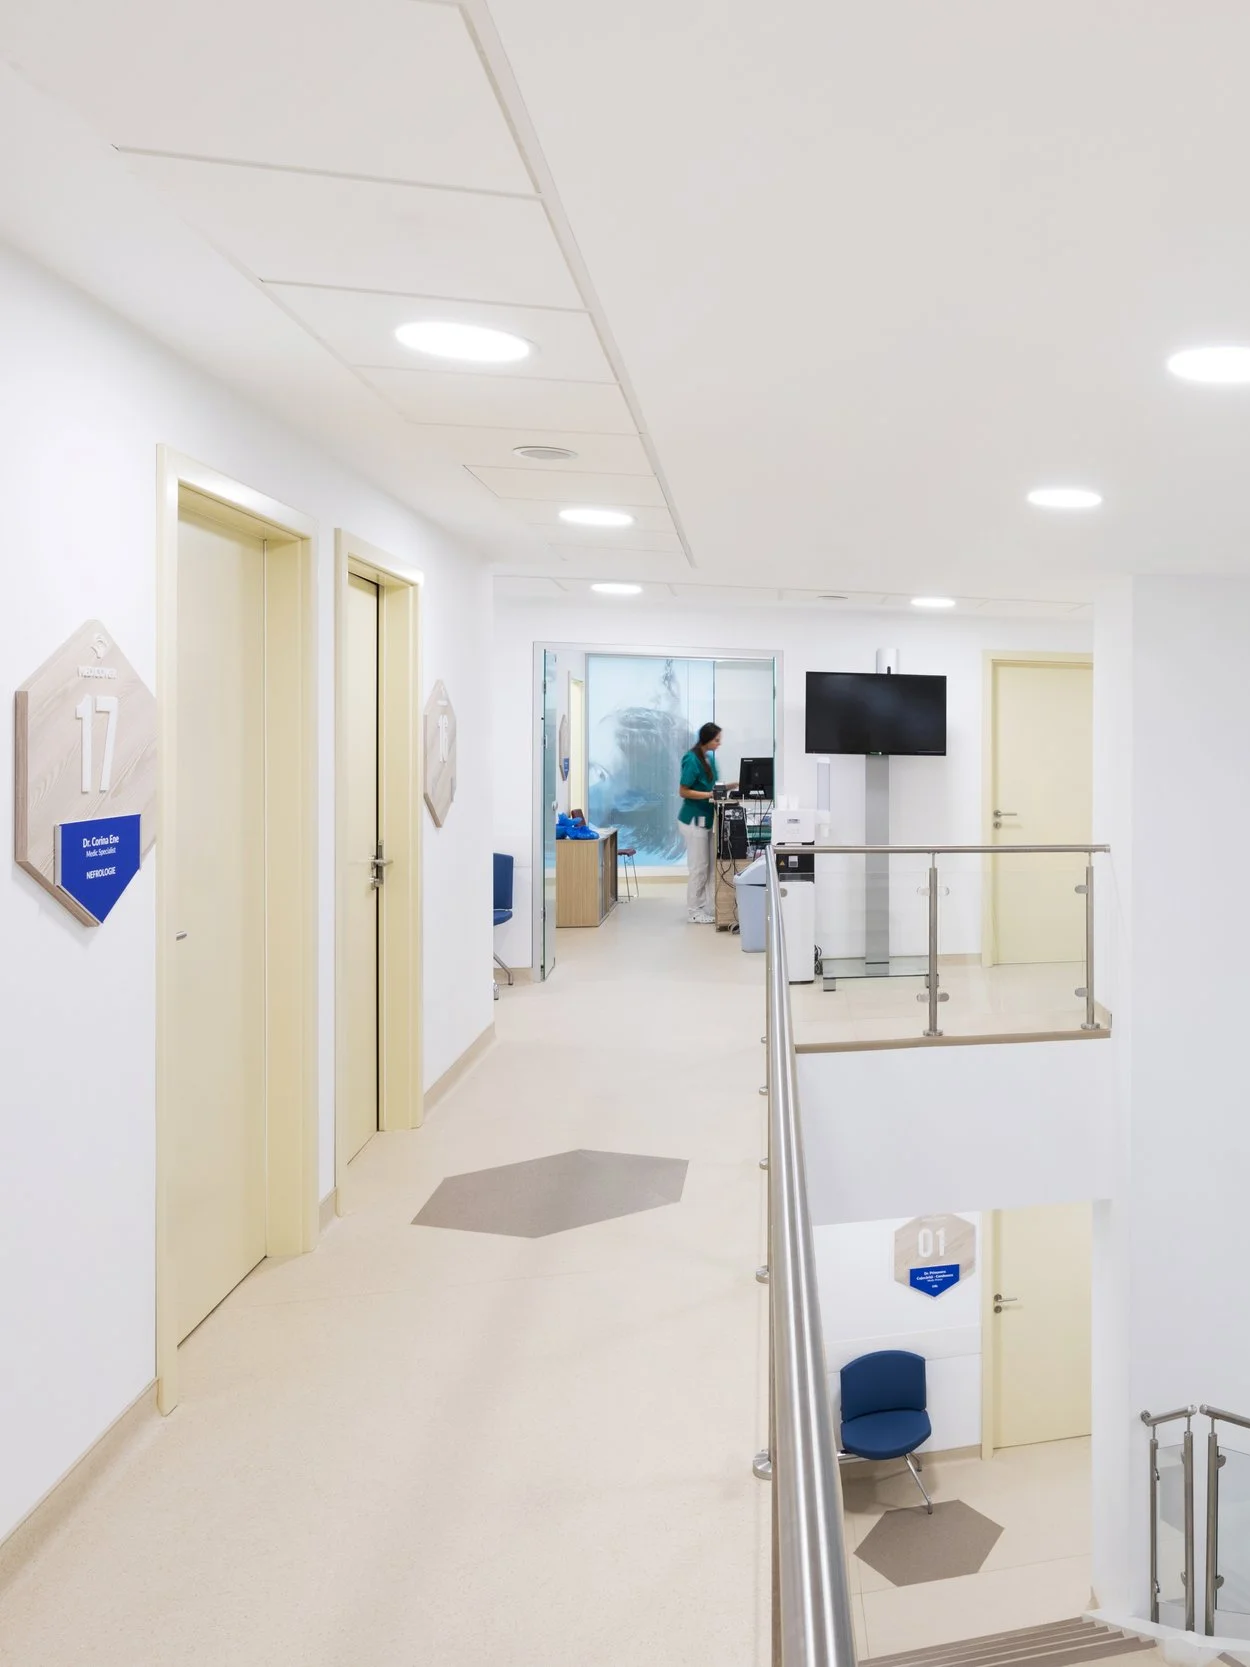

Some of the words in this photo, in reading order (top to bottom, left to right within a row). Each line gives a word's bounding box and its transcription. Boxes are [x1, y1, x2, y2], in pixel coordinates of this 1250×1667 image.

[75, 694, 118, 794] 17
[83, 838, 91, 848] Dr.
[92, 836, 109, 846] Corina
[110, 834, 119, 844] Ene
[86, 849, 98, 858] Medic
[86, 866, 116, 880] NEFROLOGIE
[918, 1226, 945, 1257] 01
